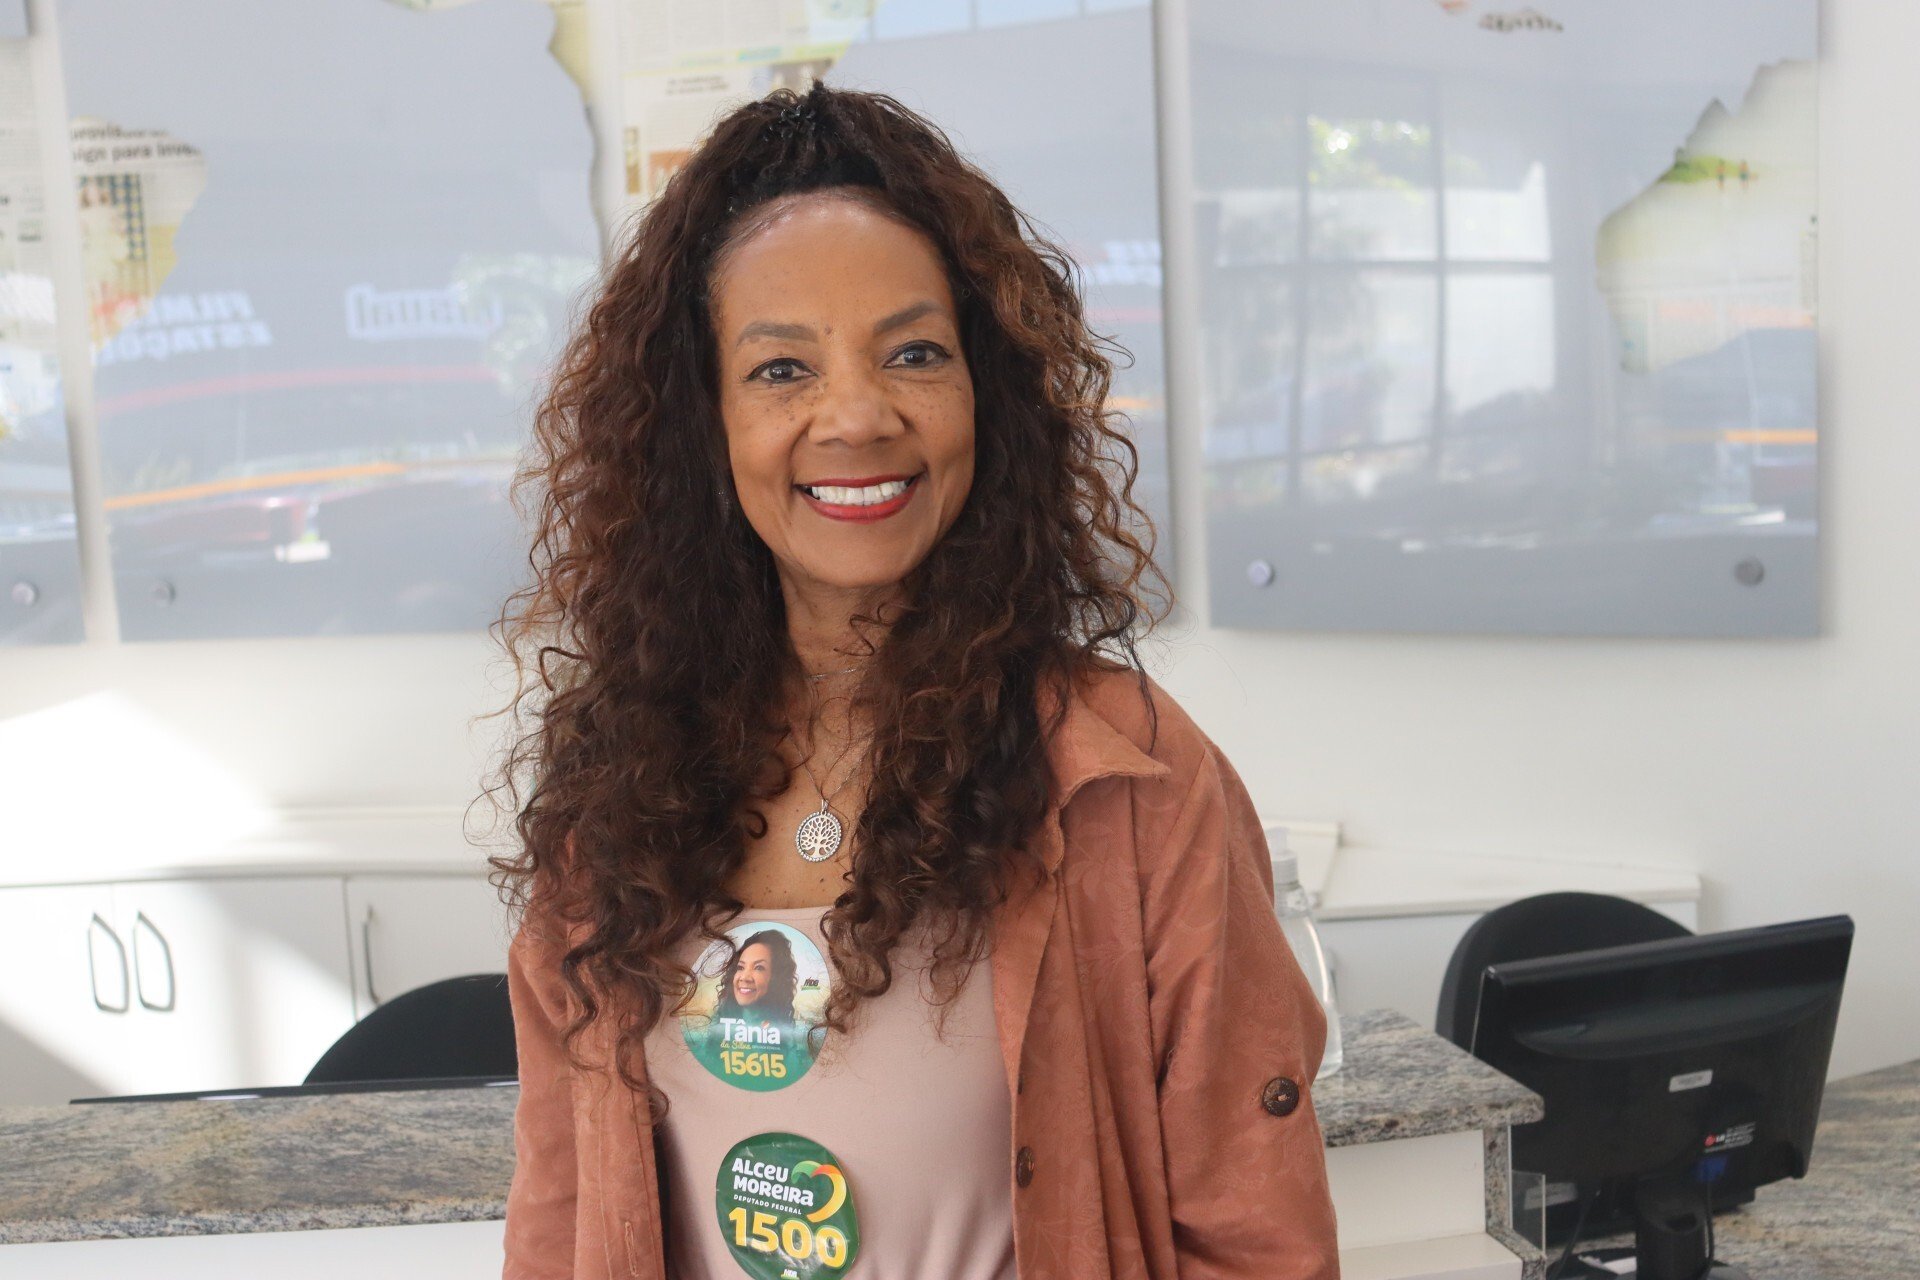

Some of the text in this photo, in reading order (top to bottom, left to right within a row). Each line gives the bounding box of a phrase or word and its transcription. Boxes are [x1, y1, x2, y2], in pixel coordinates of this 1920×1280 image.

[720, 1051, 787, 1078] 15615
[733, 1194, 802, 1215] DEPUTADO FEDERAL
[728, 1207, 847, 1268] 1500
